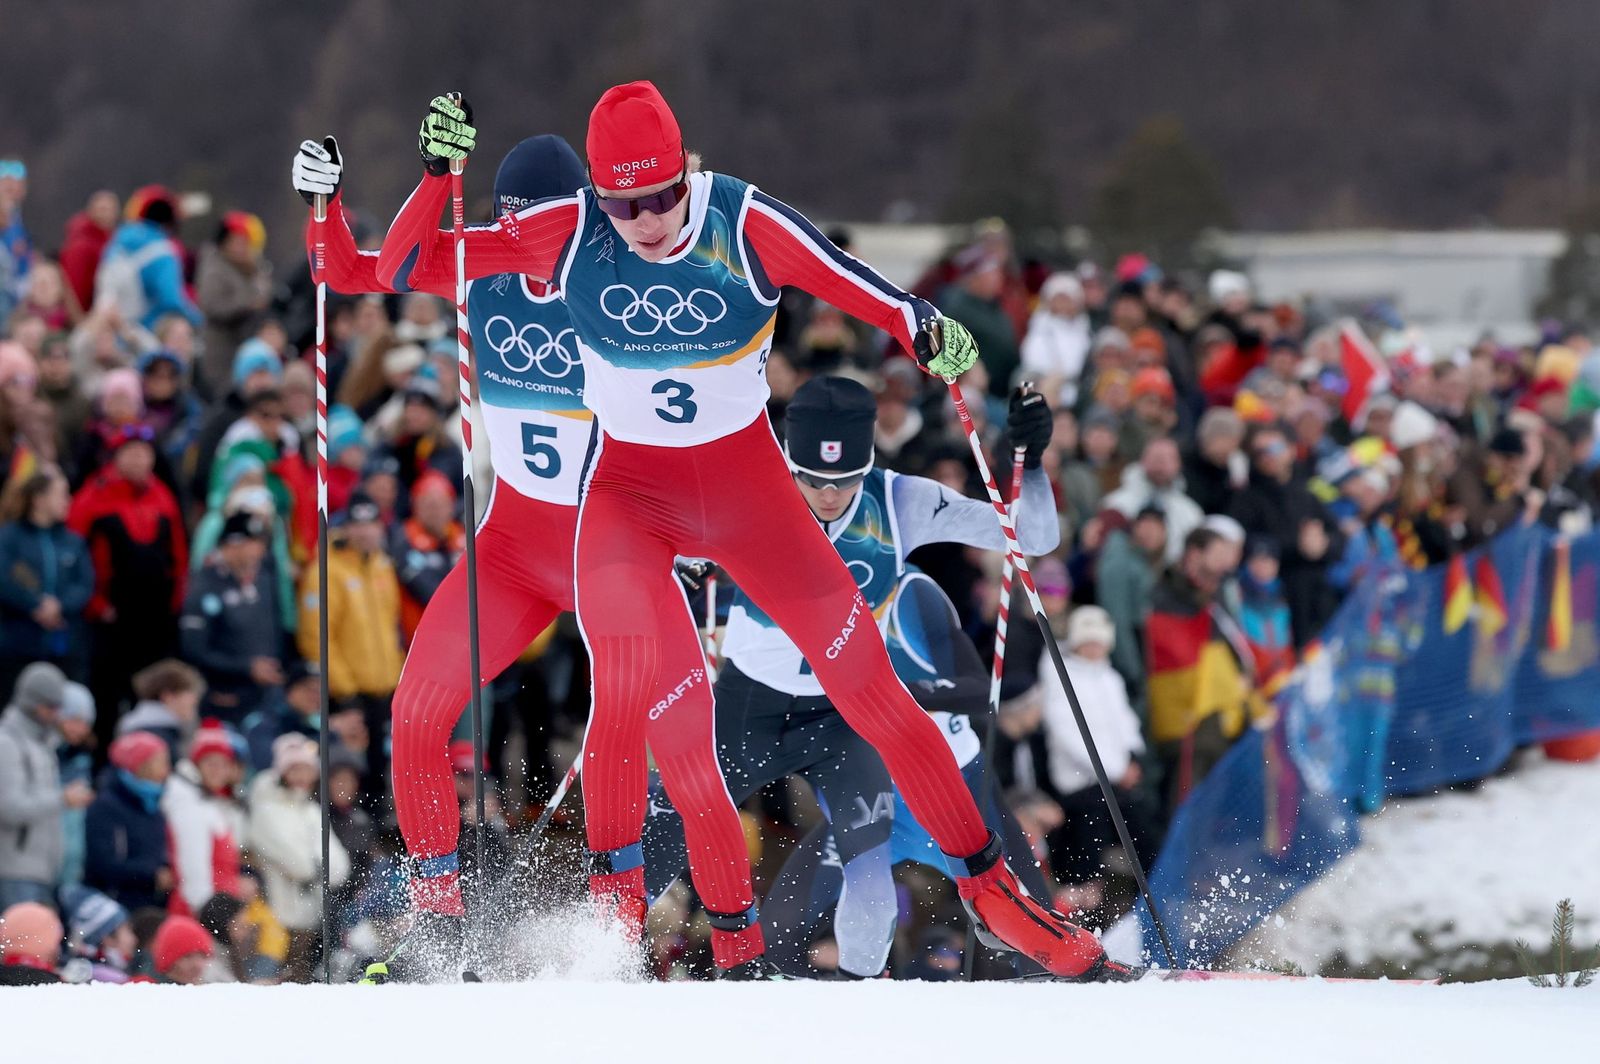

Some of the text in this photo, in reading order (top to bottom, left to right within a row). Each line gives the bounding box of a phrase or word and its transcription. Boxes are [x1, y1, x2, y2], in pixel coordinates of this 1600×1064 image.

[612, 157, 659, 174] NORGE
[652, 342, 710, 353] CORTINA
[483, 370, 524, 389] MILANO
[524, 381, 575, 397] CORTINA
[651, 378, 698, 424] 3
[520, 422, 562, 479] 5
[825, 602, 861, 660] CRAFT
[648, 675, 694, 720] CRAFT
